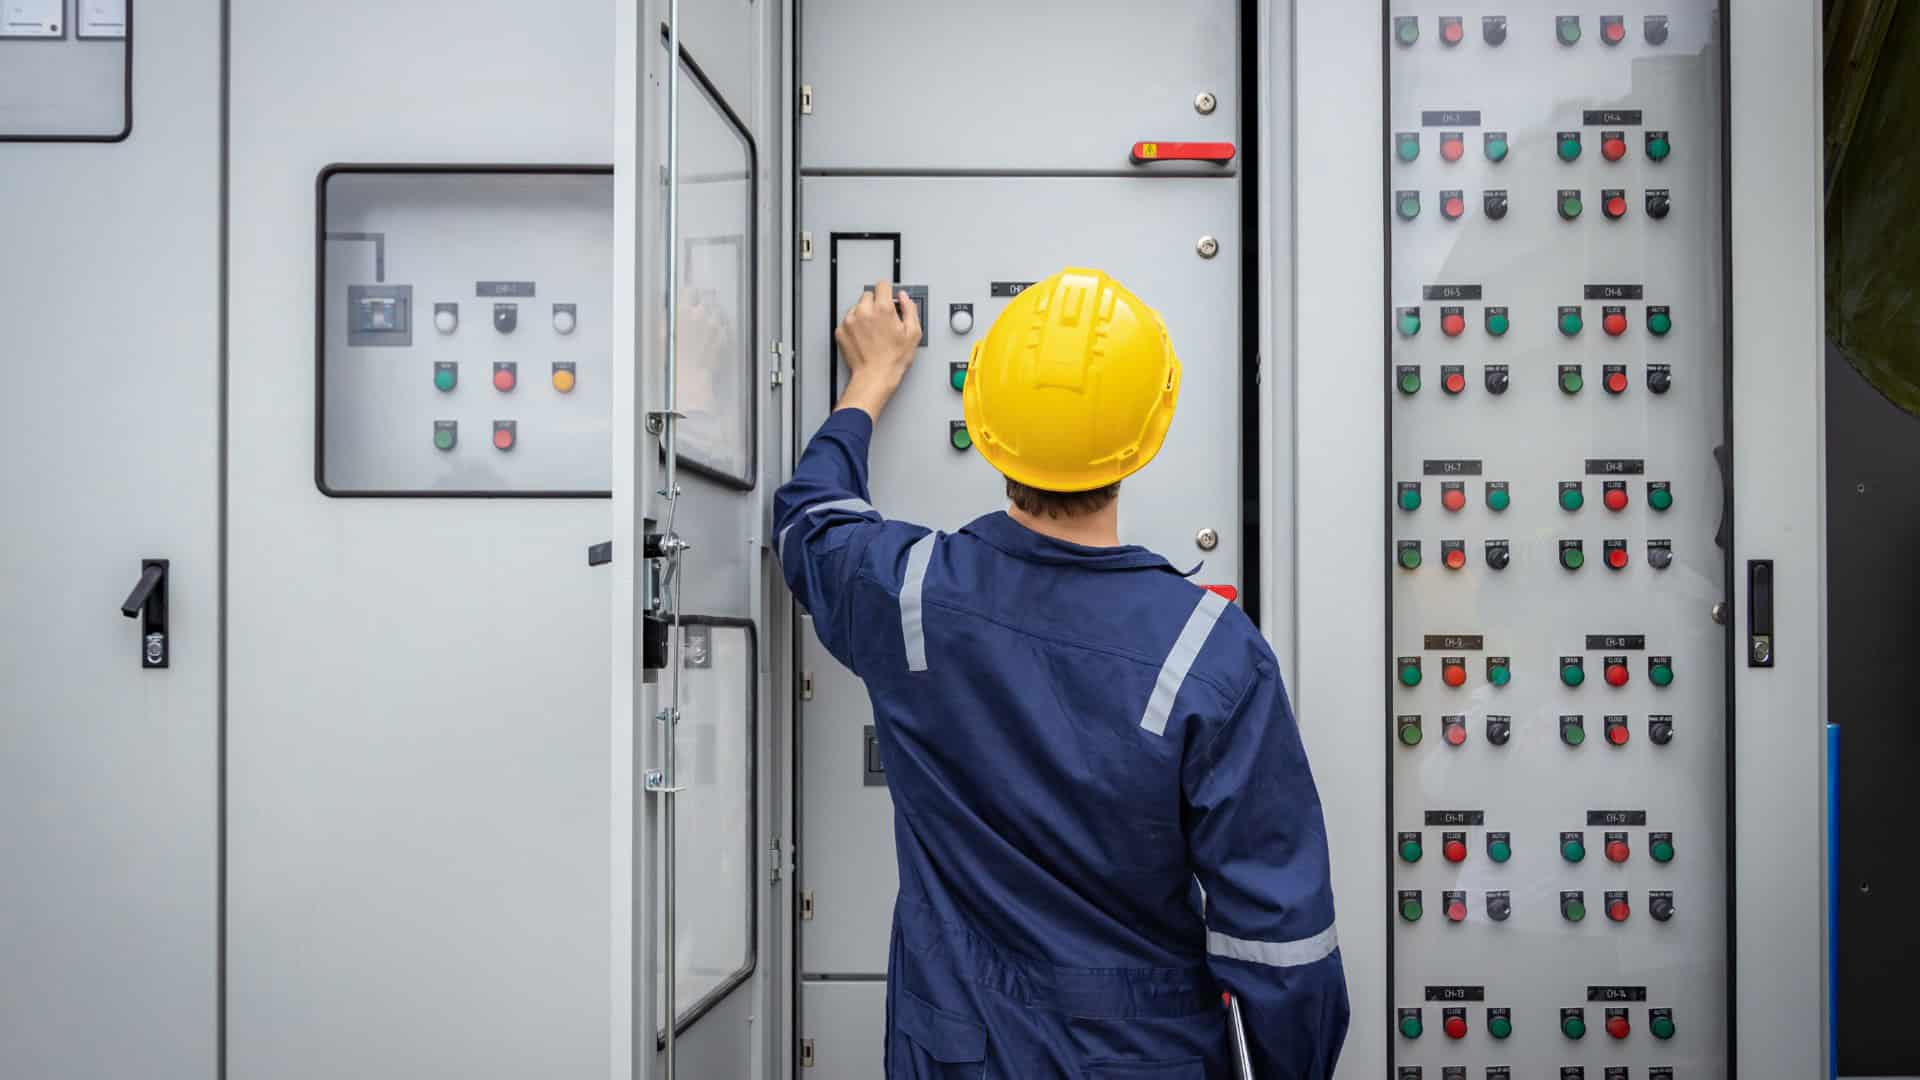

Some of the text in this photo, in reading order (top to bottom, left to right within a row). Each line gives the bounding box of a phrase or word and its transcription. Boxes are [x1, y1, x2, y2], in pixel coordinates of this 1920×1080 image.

[1444, 288, 1461, 297] CH-5
[1604, 287, 1622, 297] CH-6
[1444, 463, 1461, 472] CH-7
[1606, 462, 1624, 472] CH-8
[1444, 638, 1462, 648] CH-9
[1606, 638, 1624, 647] CH-10
[1445, 813, 1464, 823] CH-11
[1606, 814, 1625, 823] CH-12
[1444, 989, 1464, 998] CH-13
